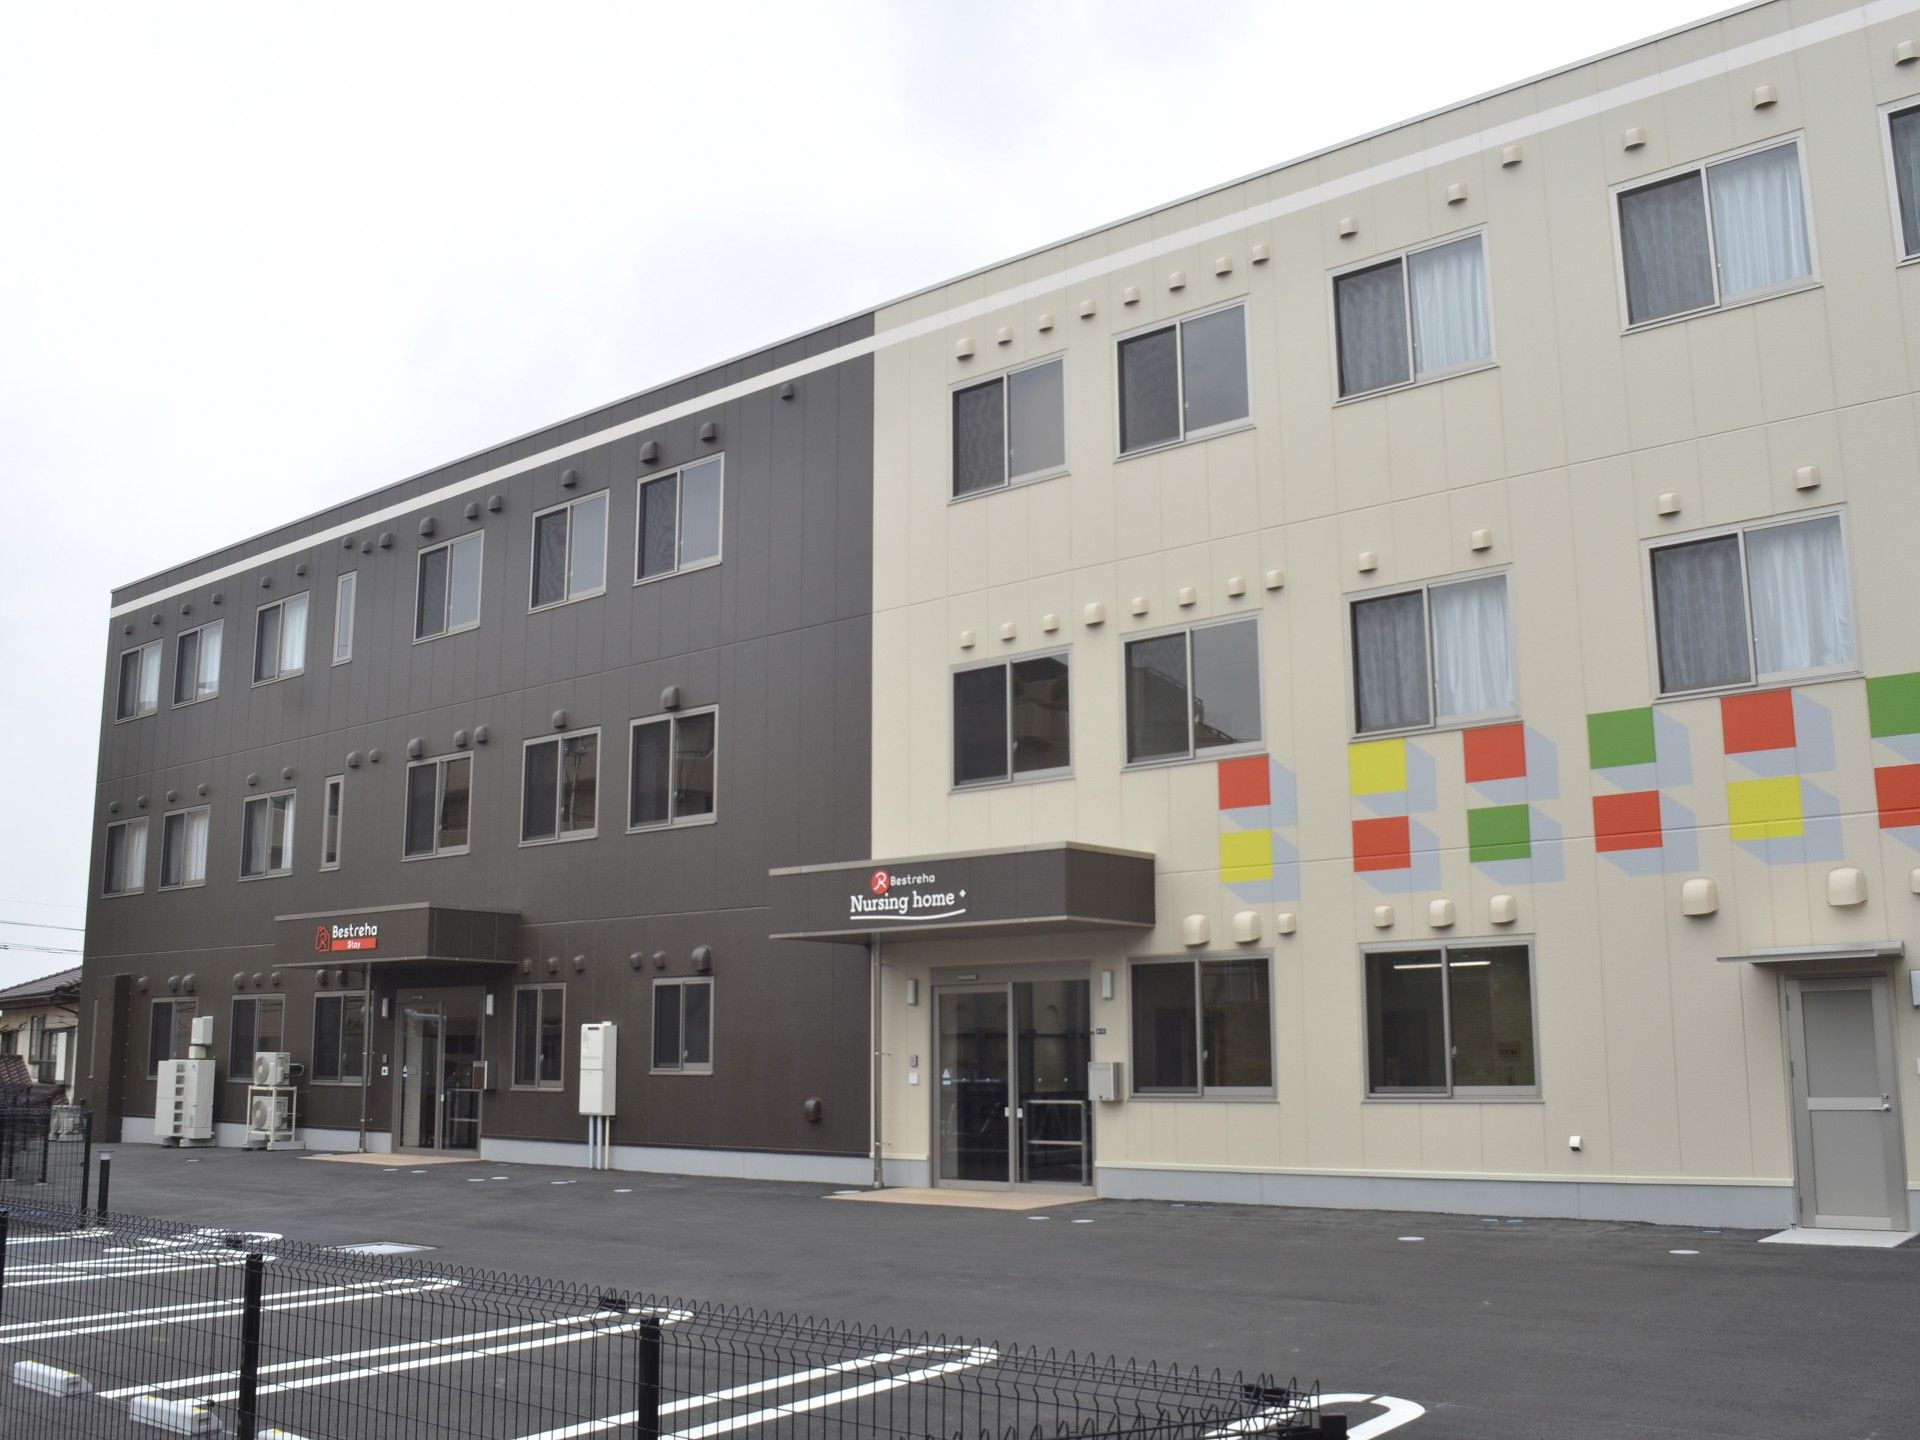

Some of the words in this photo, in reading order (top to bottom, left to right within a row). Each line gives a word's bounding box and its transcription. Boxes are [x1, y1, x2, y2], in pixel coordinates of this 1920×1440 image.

[890, 873, 935, 886] Bestreha
[850, 893, 909, 914] Nursing
[912, 890, 955, 908] home
[332, 922, 378, 939] Bestreha
[347, 940, 361, 949] Stay
